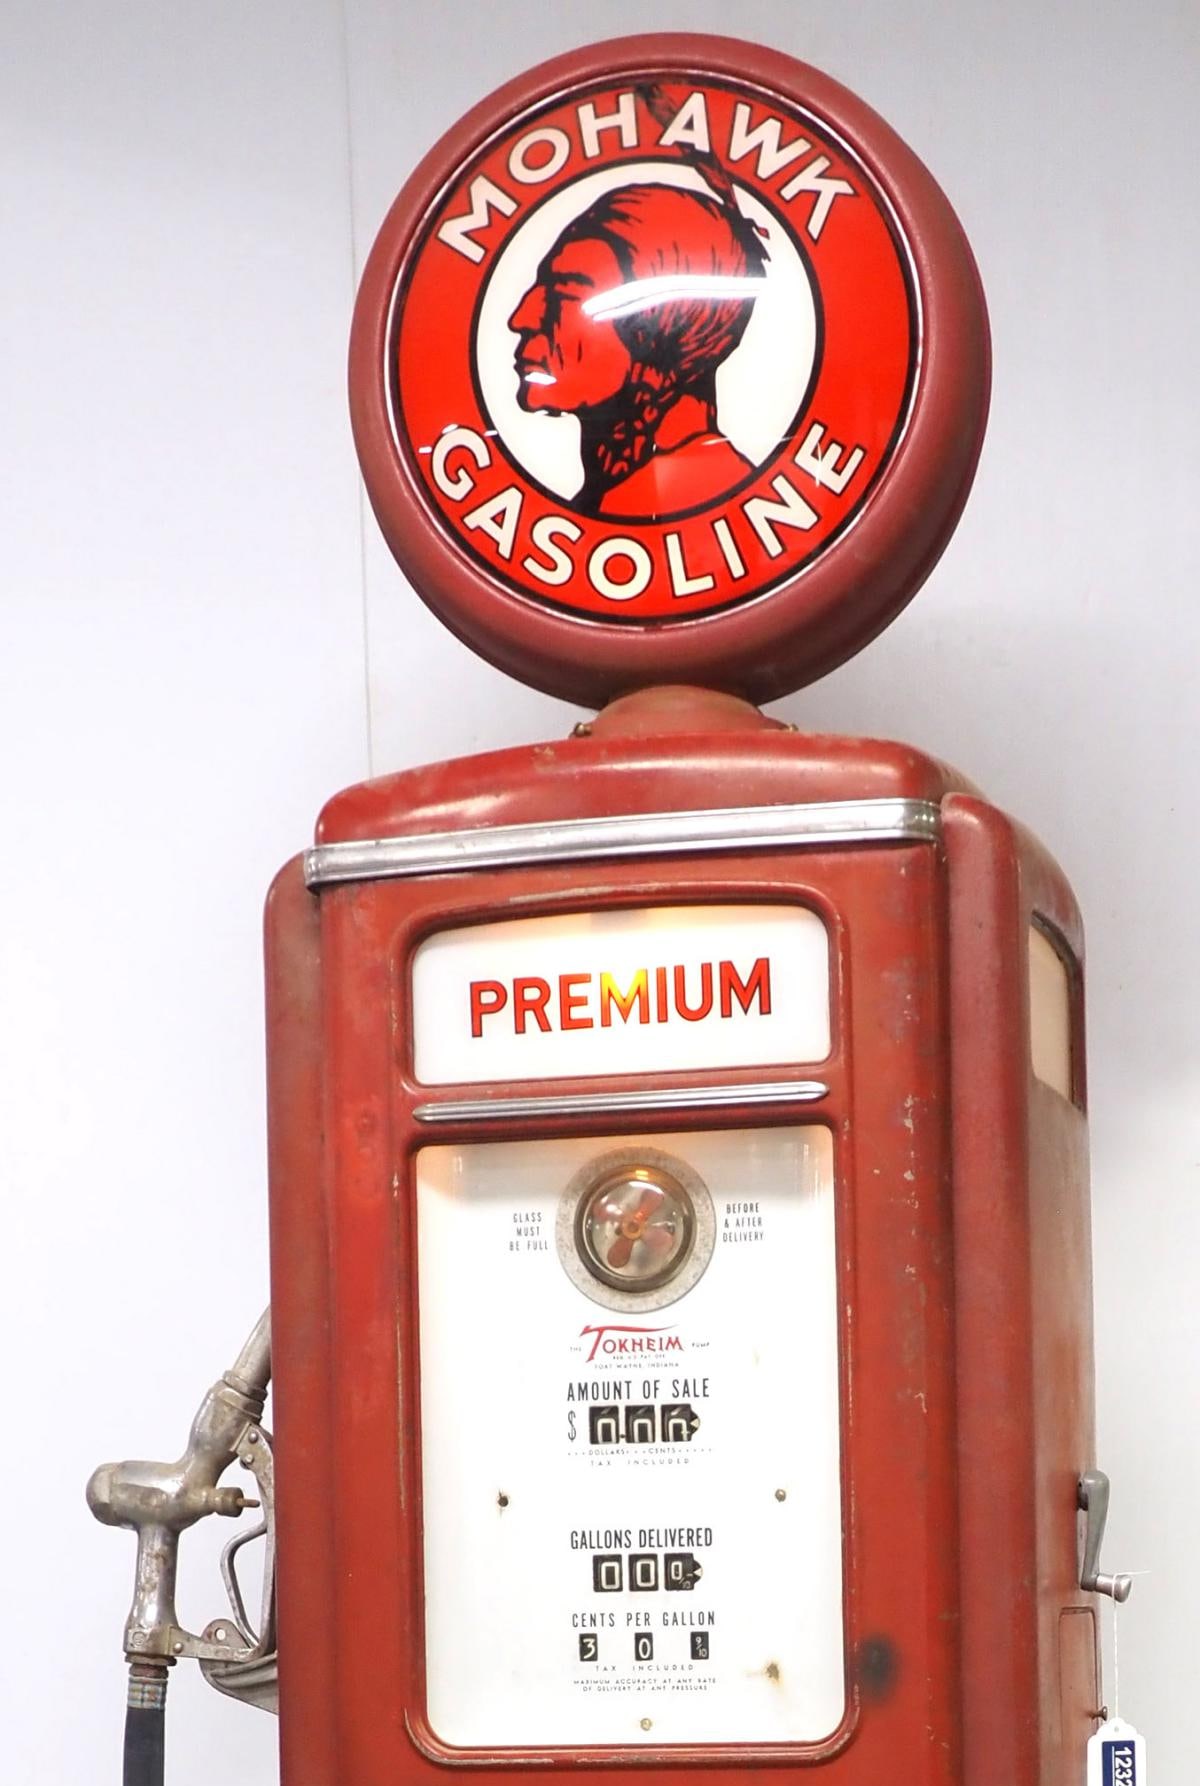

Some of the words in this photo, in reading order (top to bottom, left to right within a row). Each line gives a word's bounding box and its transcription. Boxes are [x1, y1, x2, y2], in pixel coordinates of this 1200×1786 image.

[437, 91, 856, 264] MOHAWK
[431, 423, 865, 601] GASOLINE
[470, 957, 771, 1038] PREMIUM
[513, 1211, 542, 1223] GLASS
[726, 1202, 759, 1214] BEFORE
[516, 1226, 540, 1237] MUST
[724, 1218, 730, 1228] &
[735, 1216, 762, 1228] AFTER
[509, 1240, 520, 1251] BE
[527, 1239, 548, 1251] FULL
[722, 1231, 764, 1242] DELIVERY
[579, 1324, 685, 1363] TOKHEIM
[566, 1380, 632, 1401] AMOUNT
[642, 1379, 660, 1400] OF
[671, 1377, 709, 1399] SALE
[567, 1410, 577, 1442] $
[626, 1457, 690, 1466] INCLUDED
[570, 1529, 632, 1550] GALLONS
[638, 1527, 713, 1548] DELIVERED
[572, 1612, 615, 1628] CENTS
[626, 1611, 652, 1627] PER
[662, 1610, 716, 1627] GALLON
[582, 1638, 596, 1659] 3
[638, 1637, 651, 1659] 0
